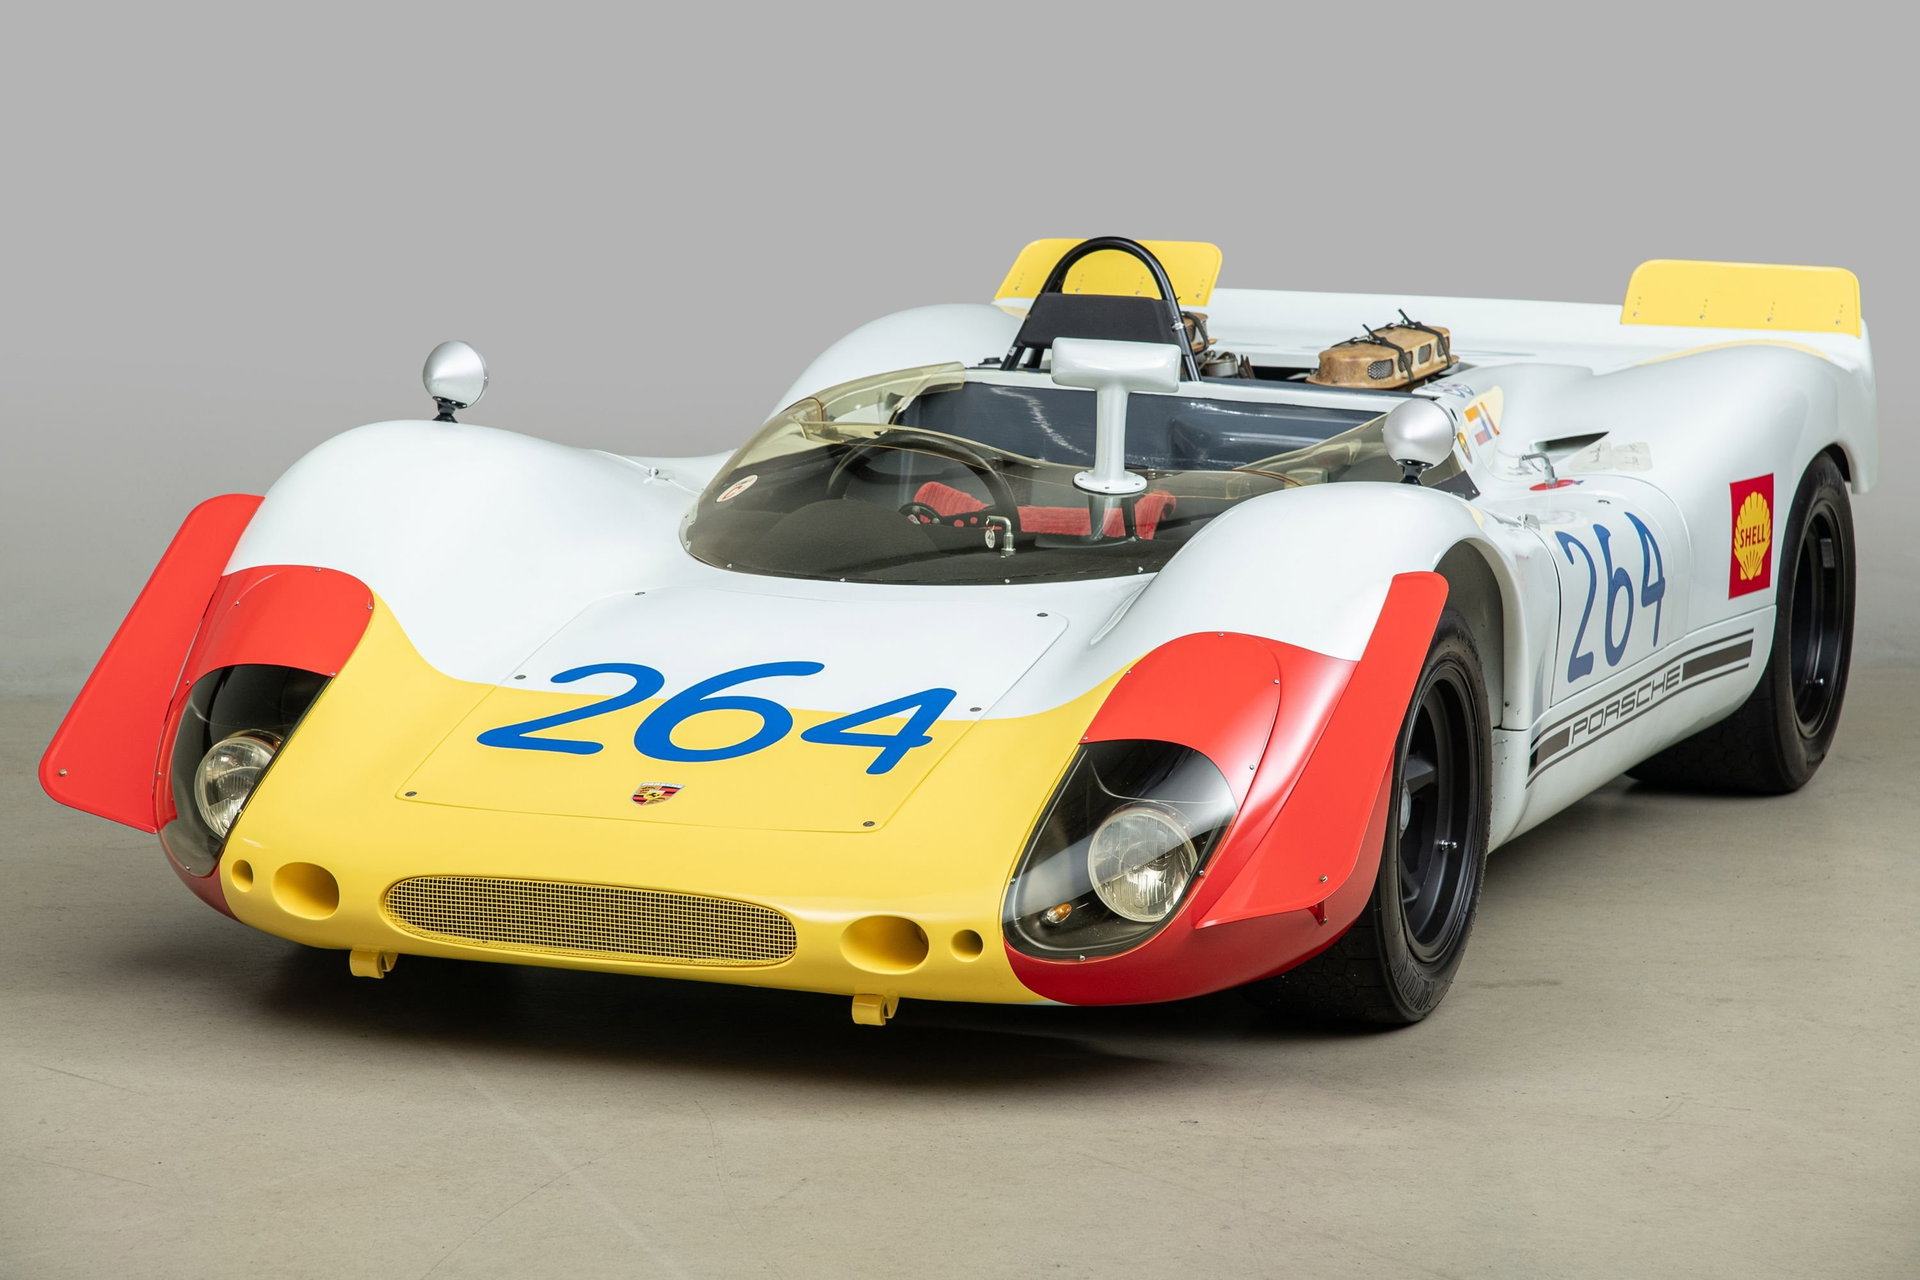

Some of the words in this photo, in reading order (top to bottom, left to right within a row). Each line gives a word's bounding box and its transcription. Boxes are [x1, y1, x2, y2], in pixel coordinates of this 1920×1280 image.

[1740, 523, 1765, 548] SHELL
[1555, 511, 1665, 683] 264
[476, 661, 957, 774] 264
[1572, 664, 1681, 744] PORSCHE
